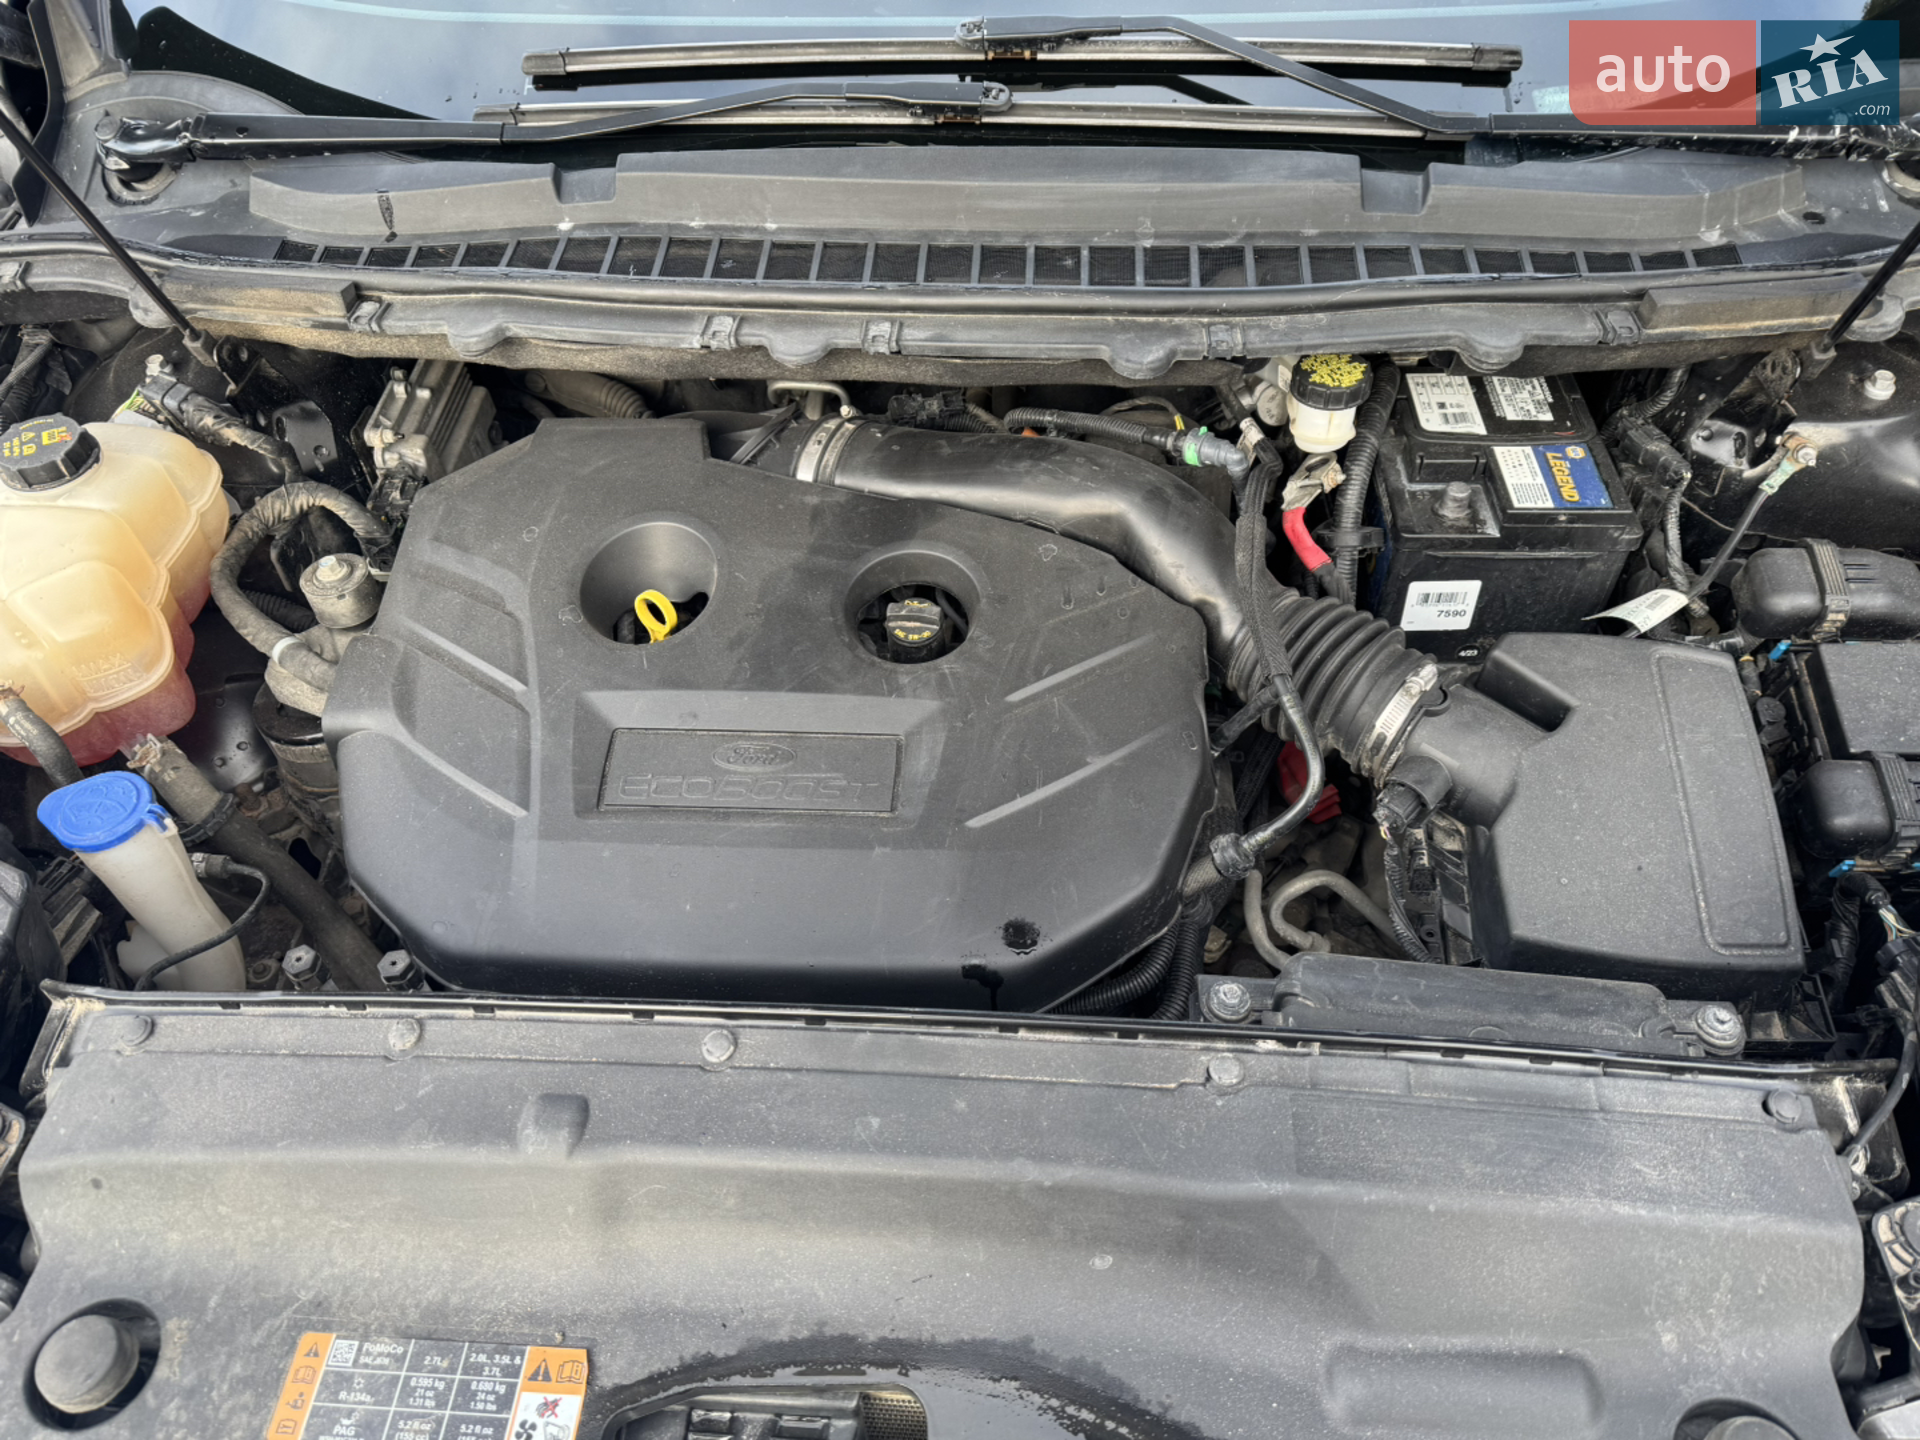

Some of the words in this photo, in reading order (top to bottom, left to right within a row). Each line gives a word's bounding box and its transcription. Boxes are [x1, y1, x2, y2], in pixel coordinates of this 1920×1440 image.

[1546, 452, 1580, 502] LEGEND
[1436, 609, 1467, 618] 7590
[726, 744, 781, 767] Ford
[362, 1342, 404, 1354] FoMoCo
[423, 1355, 442, 1365] 2.7L
[434, 1378, 446, 1390] kg
[494, 1381, 506, 1395] kg
[397, 1420, 412, 1429] 5.2
[459, 1423, 474, 1433] 5.2
[332, 1425, 356, 1436] PAG
